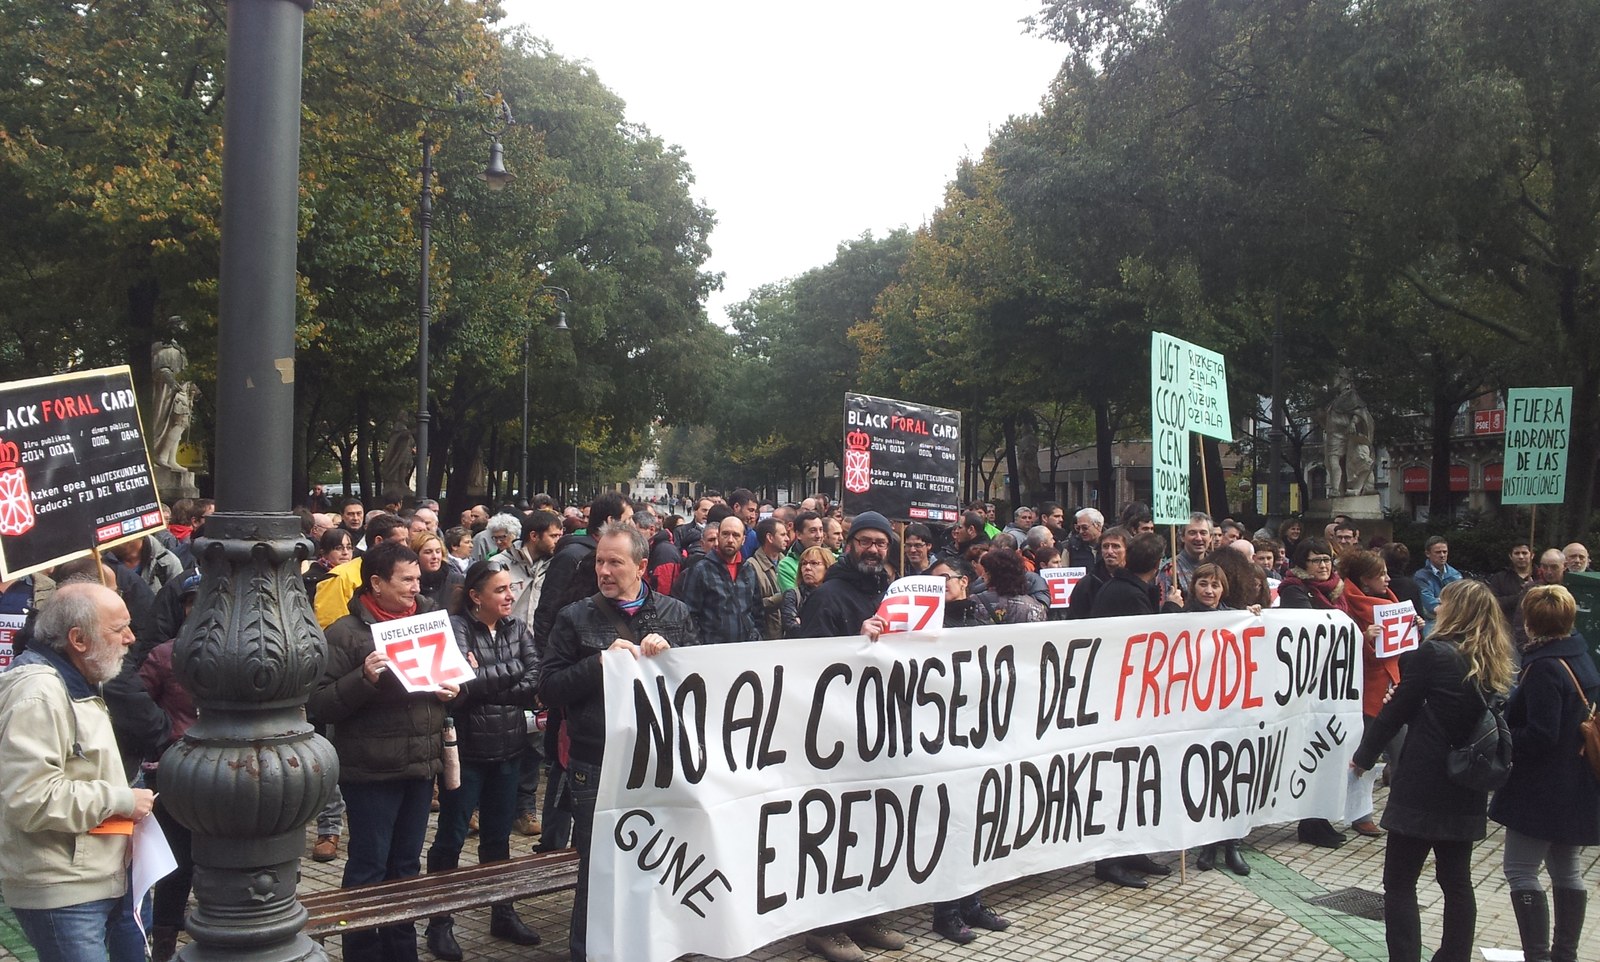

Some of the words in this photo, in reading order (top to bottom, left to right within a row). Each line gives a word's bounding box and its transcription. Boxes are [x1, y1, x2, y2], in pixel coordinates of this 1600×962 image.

[1160, 339, 1180, 384] UGT
[0, 404, 40, 431] ACK
[41, 394, 99, 422] FORAL
[101, 389, 135, 411] CARD
[848, 411, 888, 429] BLACK
[891, 415, 929, 435] FORAL
[932, 423, 958, 439] CARD
[1156, 386, 1186, 431] CCOO
[1475, 421, 1489, 430] PSOE
[1514, 397, 1564, 423] FUERA
[21, 449, 45, 463] 2014
[49, 443, 75, 457] 0011
[870, 442, 887, 451] 2014
[889, 444, 906, 454] 0011
[1159, 429, 1182, 469] CEN
[1508, 428, 1566, 449] LADRONES
[1156, 468, 1178, 492] TODO
[1517, 452, 1531, 471] DE
[1537, 452, 1559, 471] LAS
[31, 487, 59, 501] Azken
[63, 480, 86, 493] epea
[90, 463, 147, 485] HAUTESKUNDEAK
[34, 497, 72, 515] Caduca:
[78, 490, 94, 503] FIN
[98, 485, 112, 498] DEL
[115, 476, 149, 492] REGIMEN
[900, 480, 913, 489] FIN
[929, 483, 955, 493] REGIMEN
[381, 619, 447, 641] USTELKERIARIK
[1382, 613, 1414, 654] EZ
[386, 632, 464, 686] EZ
[626, 672, 707, 789] NO
[722, 665, 786, 771] AL
[804, 644, 1014, 770] CONSEJO
[1036, 638, 1101, 740] DEL
[1114, 626, 1265, 721] FRAUDE
[1290, 714, 1347, 799] GUNE
[757, 782, 950, 915] EREDU
[973, 744, 1161, 868] ALDAKETA
[614, 809, 732, 918] GUNE
